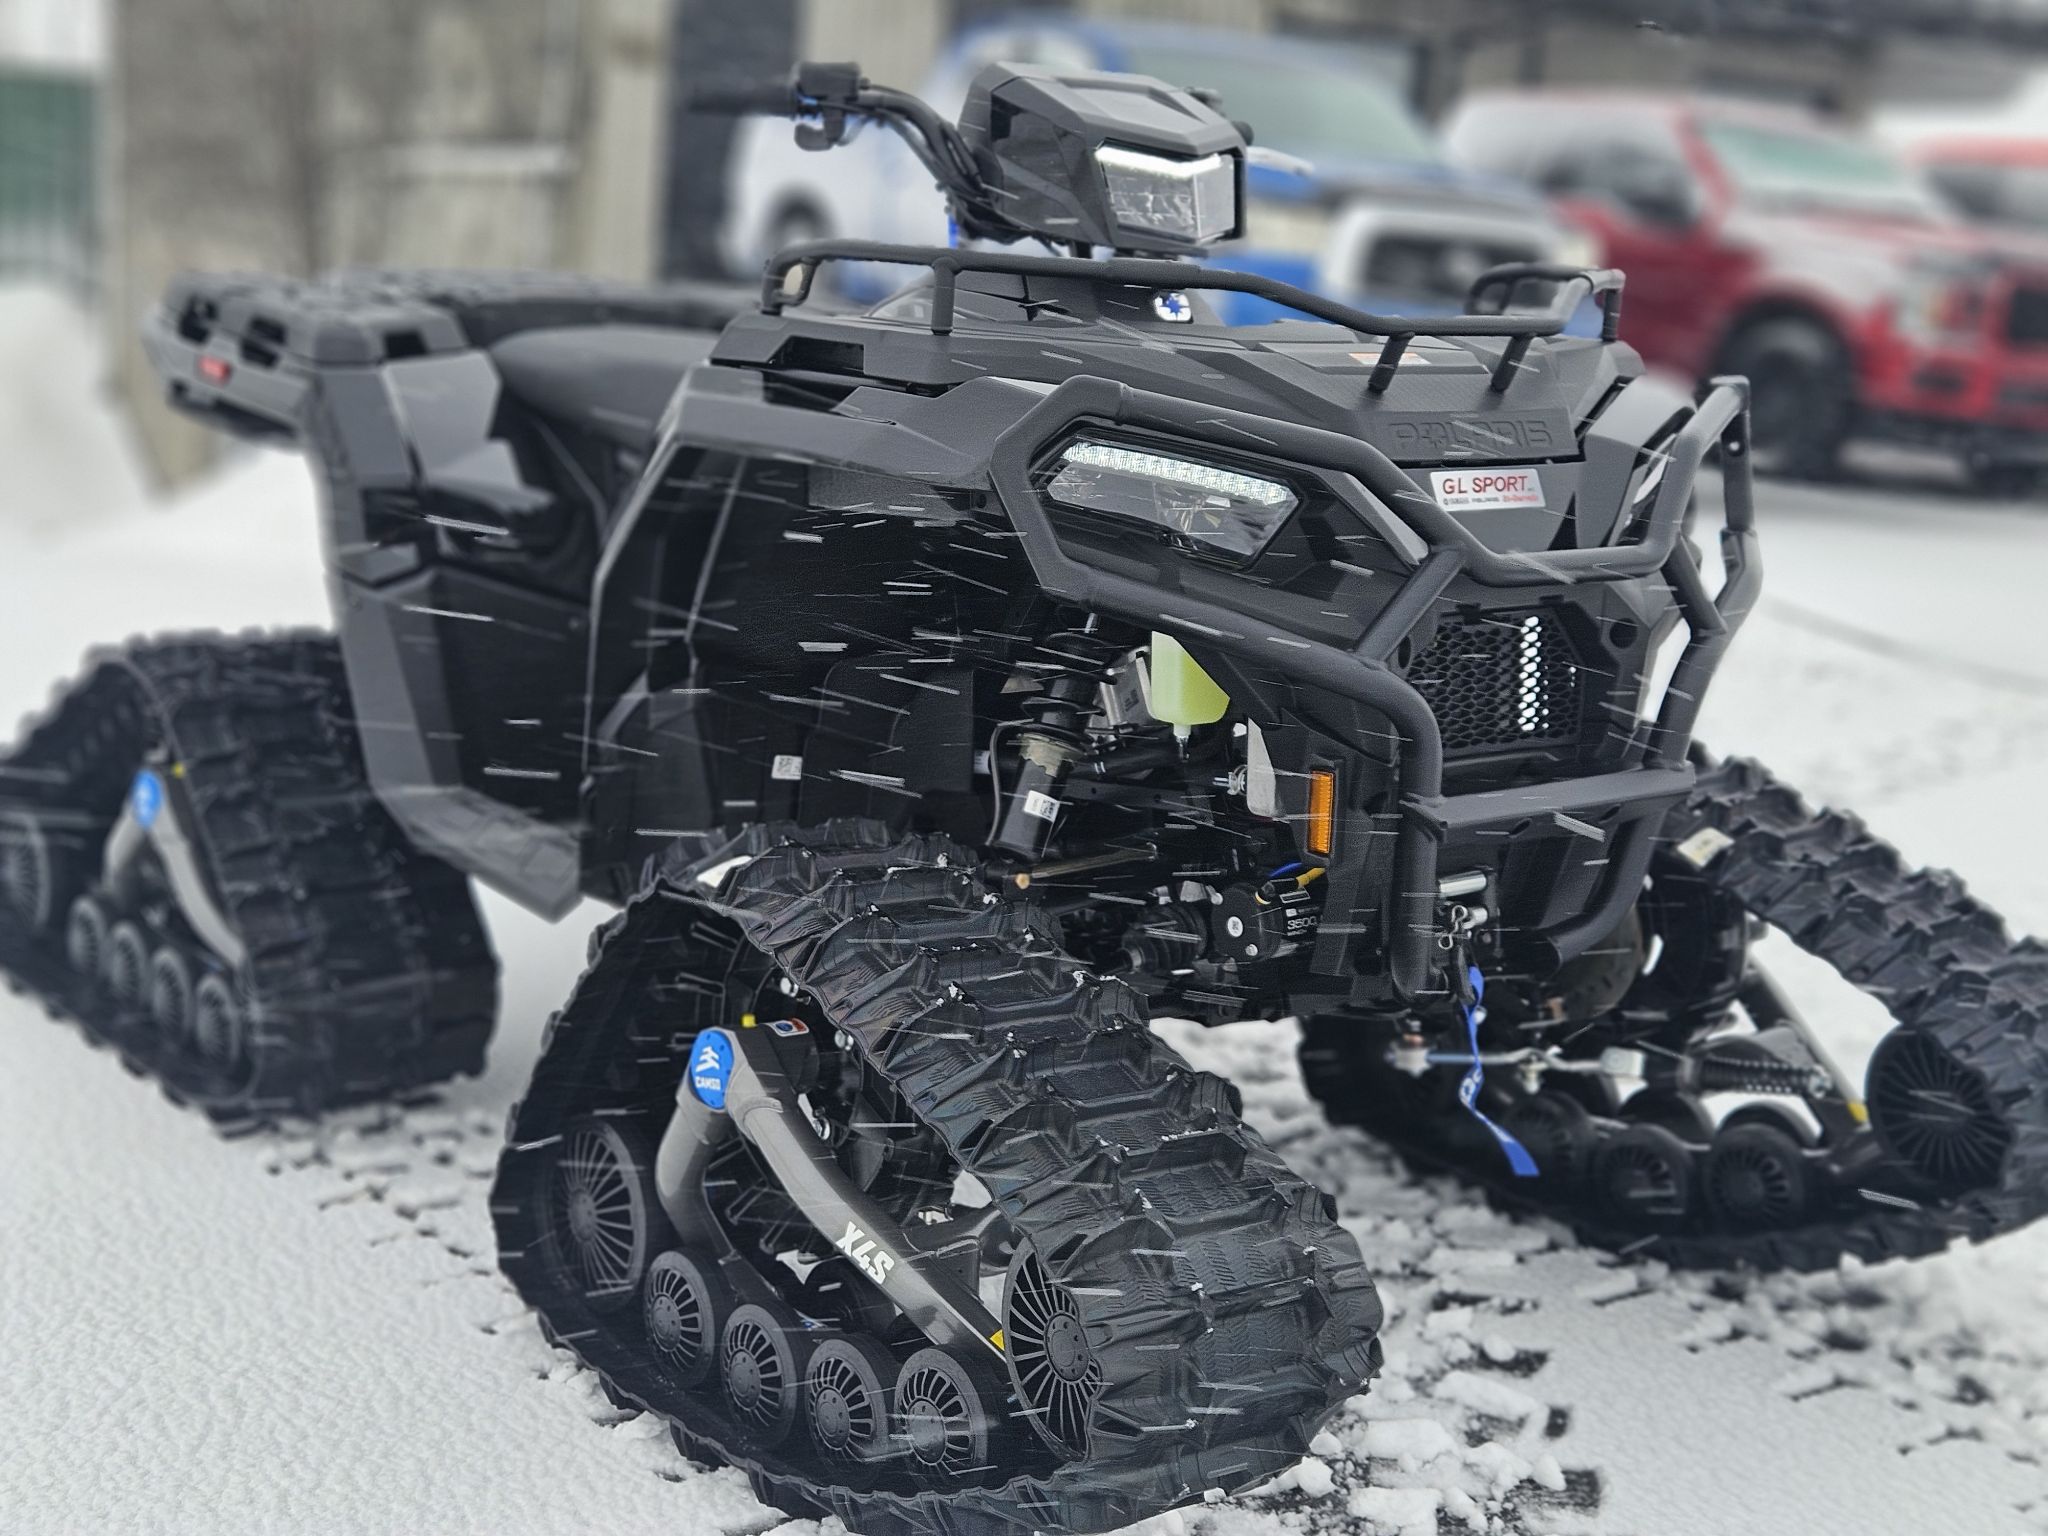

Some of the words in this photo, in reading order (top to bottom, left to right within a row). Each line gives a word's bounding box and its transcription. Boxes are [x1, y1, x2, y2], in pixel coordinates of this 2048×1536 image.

[1389, 419, 1553, 450] POLARIS
[1442, 477, 1468, 495] GL
[1472, 475, 1528, 494] SPORT
[835, 1221, 895, 1285] X4S
